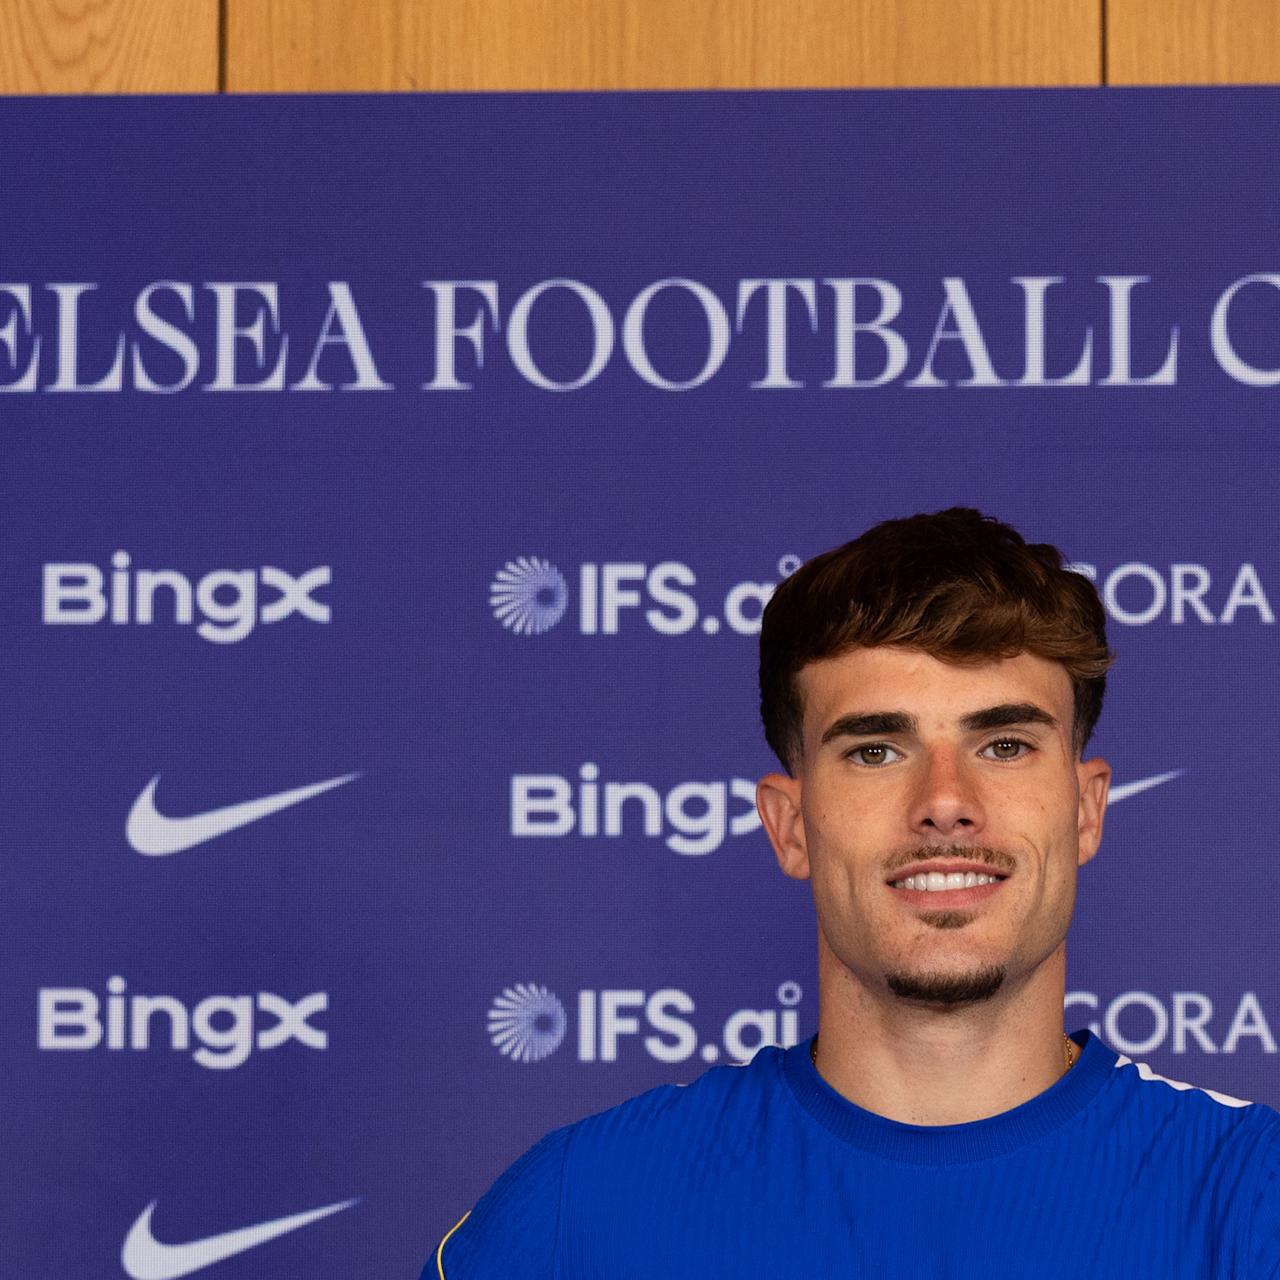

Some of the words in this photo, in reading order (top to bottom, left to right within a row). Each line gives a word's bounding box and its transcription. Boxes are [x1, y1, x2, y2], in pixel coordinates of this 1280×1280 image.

[424, 275, 1179, 391] FOOTBALL
[580, 552, 803, 635] IFS.a
[1062, 561, 1277, 626] ORA
